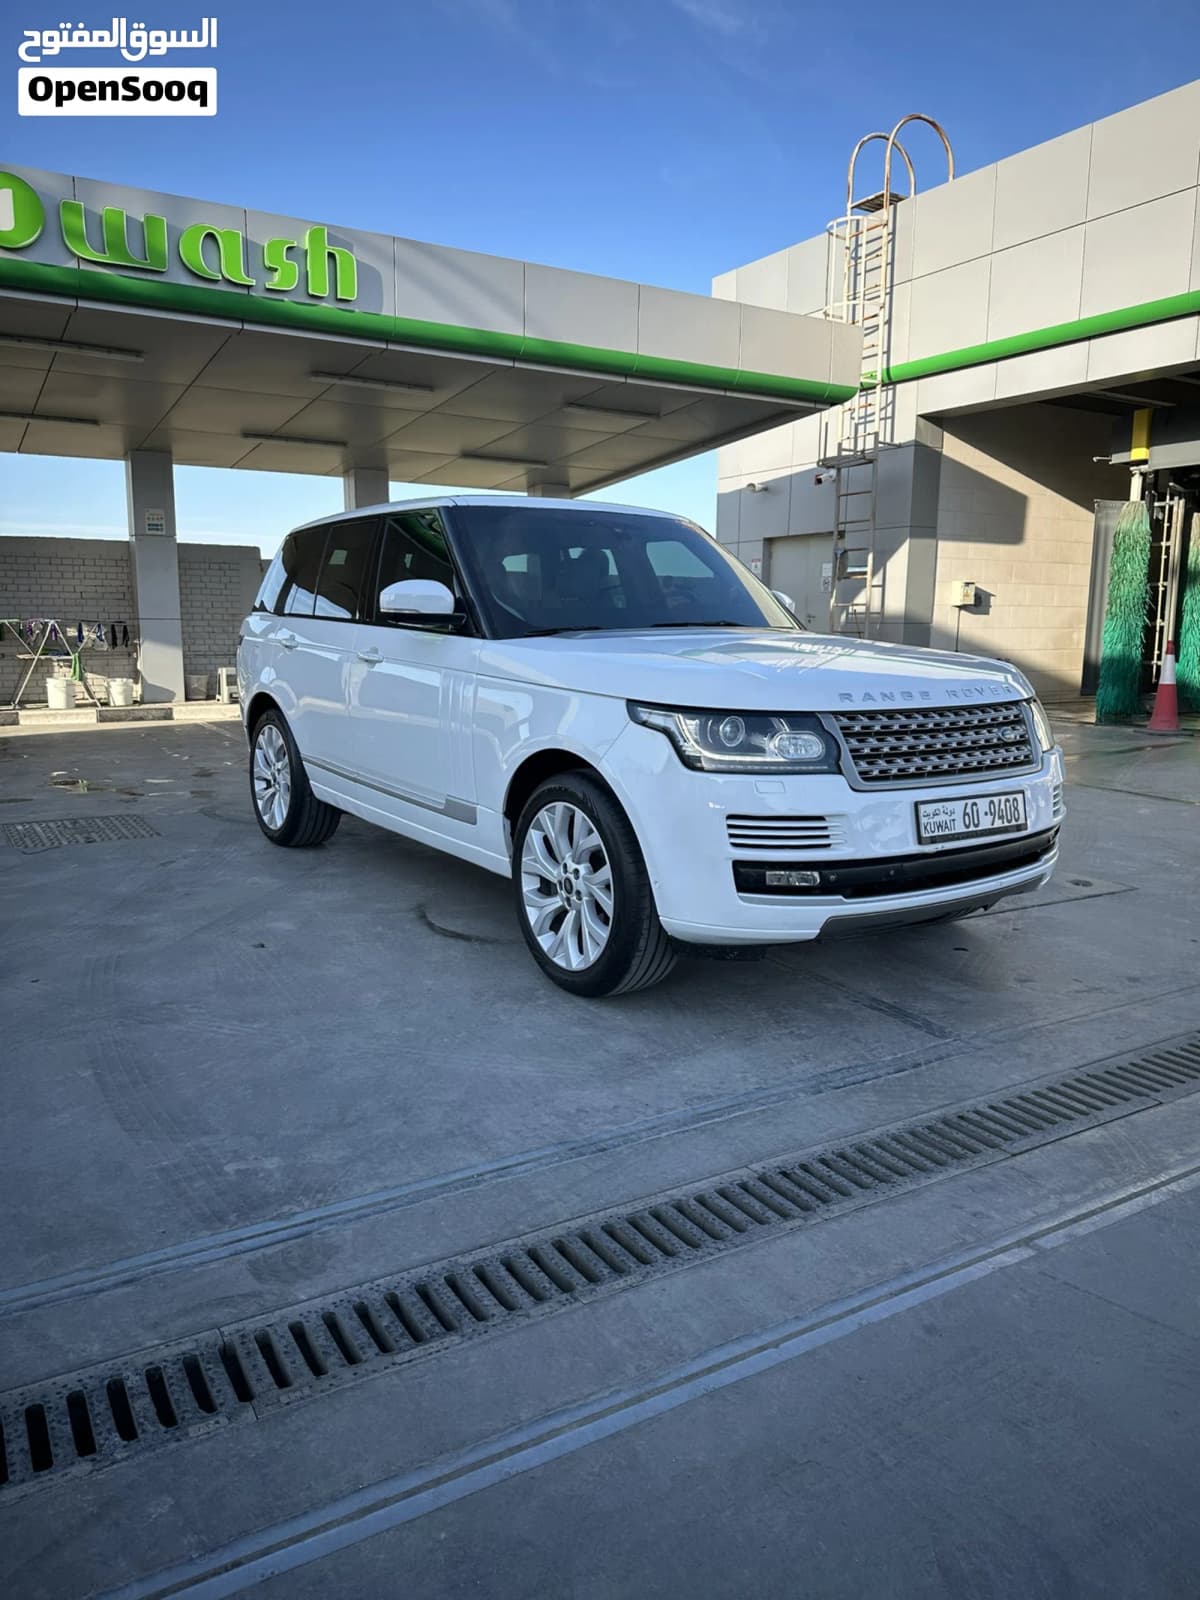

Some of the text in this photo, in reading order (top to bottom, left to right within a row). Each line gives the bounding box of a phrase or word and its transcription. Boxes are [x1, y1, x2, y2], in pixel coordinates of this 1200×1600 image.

[60, 199, 358, 301] wash
[838, 684, 1013, 703] RANGE ROVER
[923, 819, 956, 835] KUWAIT
